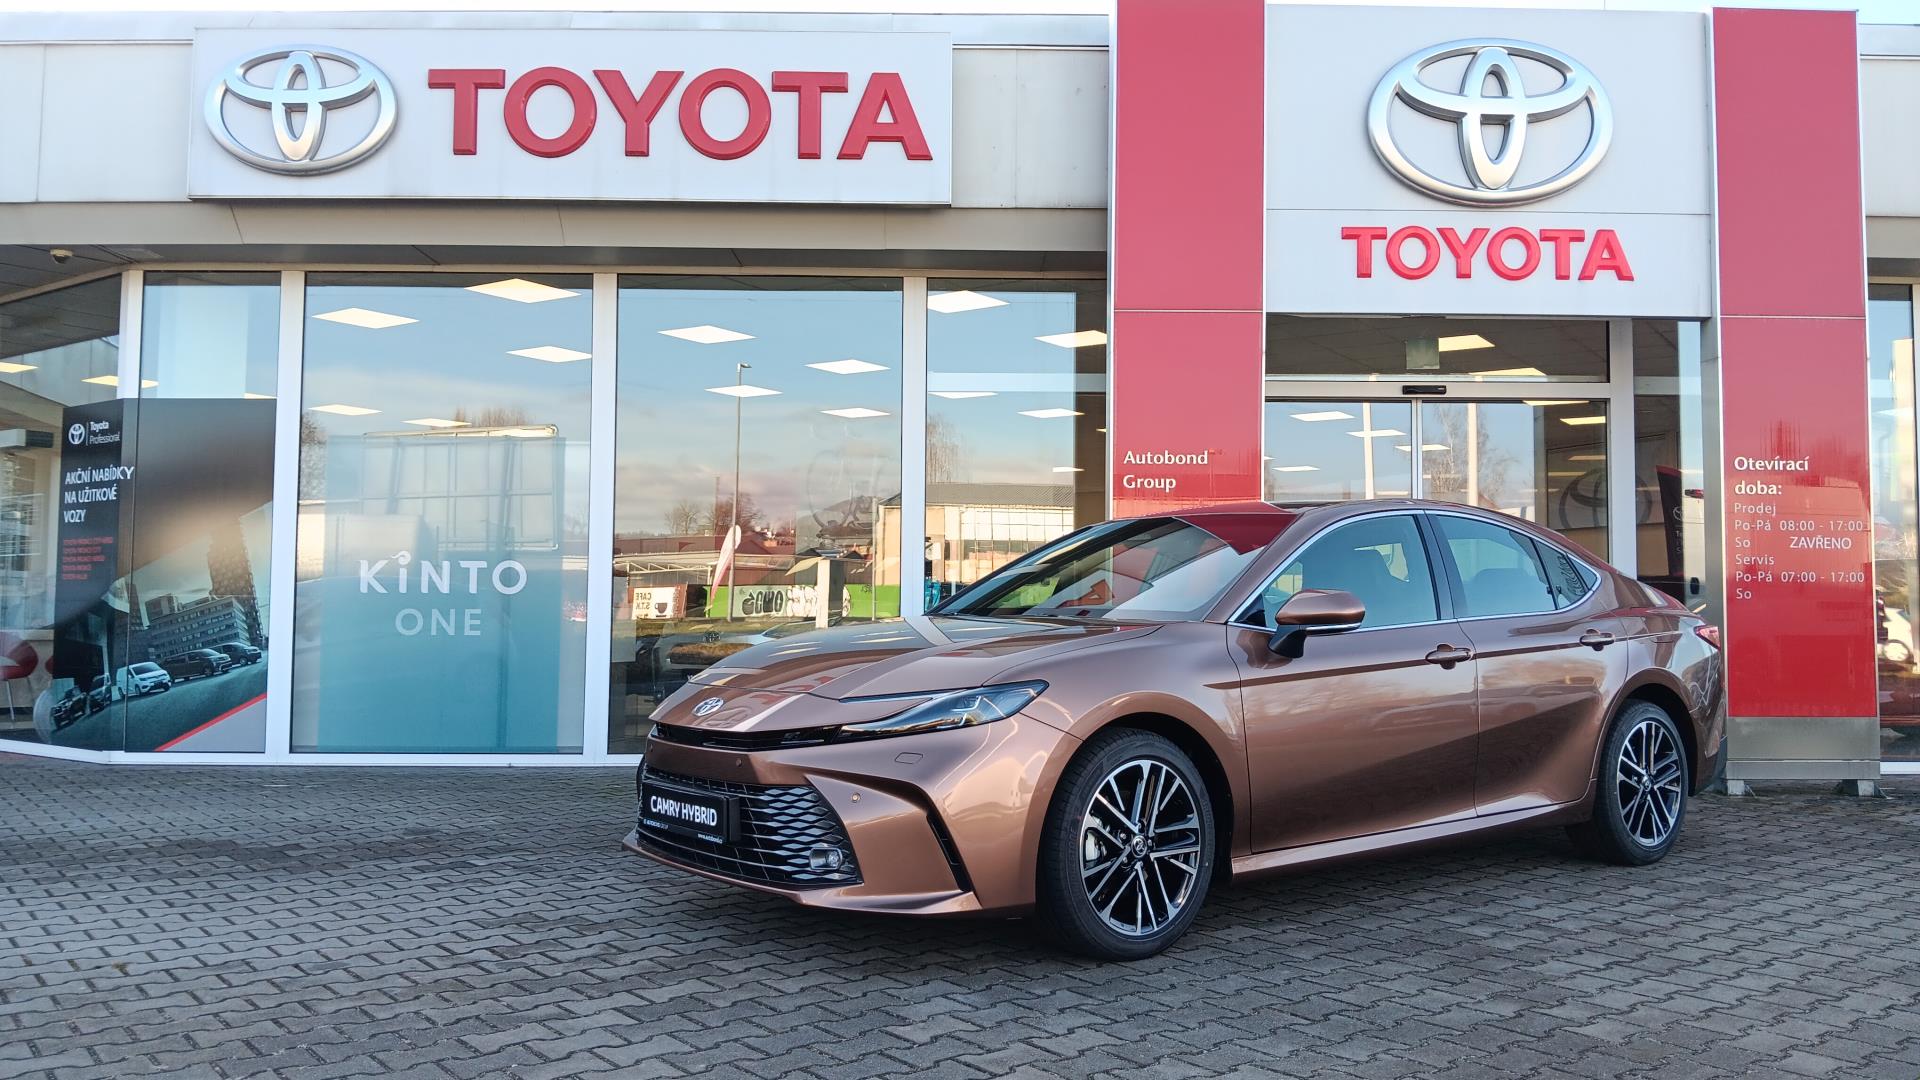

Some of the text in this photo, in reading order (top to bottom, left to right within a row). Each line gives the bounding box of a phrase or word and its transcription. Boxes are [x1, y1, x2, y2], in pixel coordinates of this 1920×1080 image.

[428, 66, 933, 160] TOYOTA
[1341, 226, 1635, 282] TOYOTA
[90, 421, 110, 432] Toyota
[89, 432, 121, 444] Professional
[1123, 449, 1208, 465] Autobond
[1734, 456, 1810, 471] Otevírací
[65, 463, 135, 485] AKČNÍ NABÍDKY
[1123, 474, 1177, 493] Group
[1734, 480, 1783, 495] doba:
[64, 484, 118, 504] NA UŽITKOVÉ
[63, 509, 87, 523] VOZY
[1734, 502, 1777, 517] Prodej
[1734, 519, 1772, 532] Po-Pá
[1779, 520, 1815, 532] 08:00
[1829, 520, 1864, 532] 17:00
[1735, 534, 1852, 550] So ZAVŘENO
[1735, 554, 1775, 565] Servis
[1735, 570, 1773, 582] Po-Pá
[1780, 571, 1816, 582] 07:00
[1830, 571, 1865, 583] 17:00
[1736, 588, 1752, 599] So
[395, 608, 482, 636] ONE
[650, 795, 681, 818] CAMRY
[681, 802, 718, 827] HYBRID
